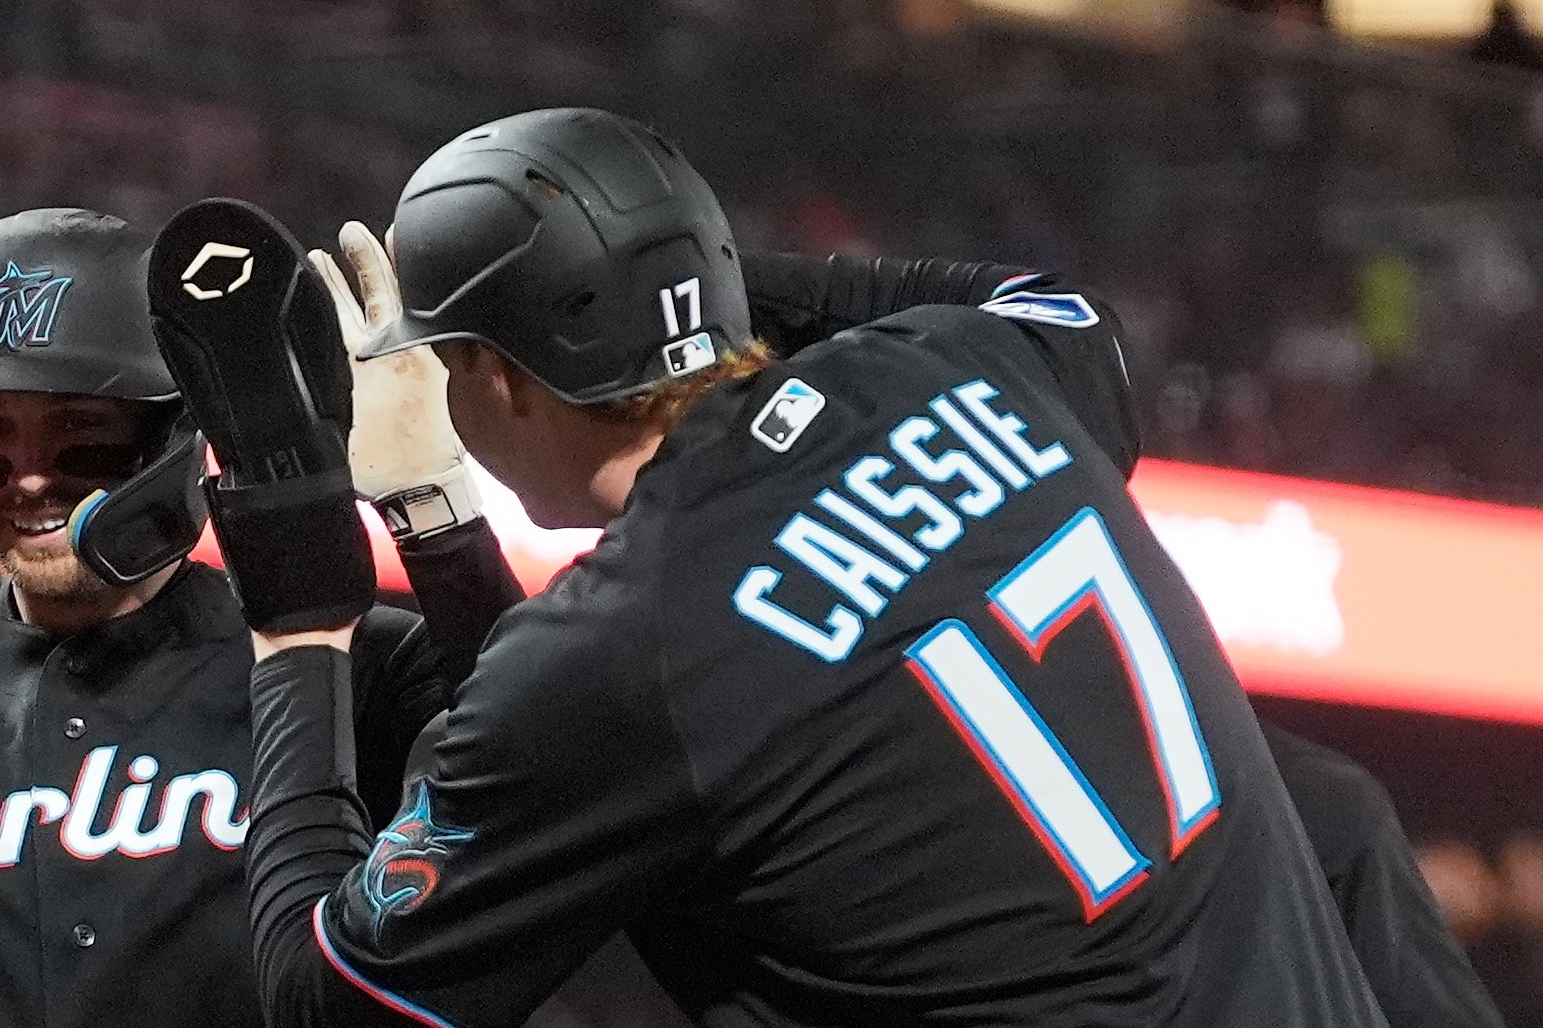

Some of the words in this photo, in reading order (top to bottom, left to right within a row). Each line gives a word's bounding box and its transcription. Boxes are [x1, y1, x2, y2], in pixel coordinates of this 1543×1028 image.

[659, 277, 701, 338] 17
[733, 378, 1073, 663] CAISSIE
[903, 506, 1221, 923] 17
